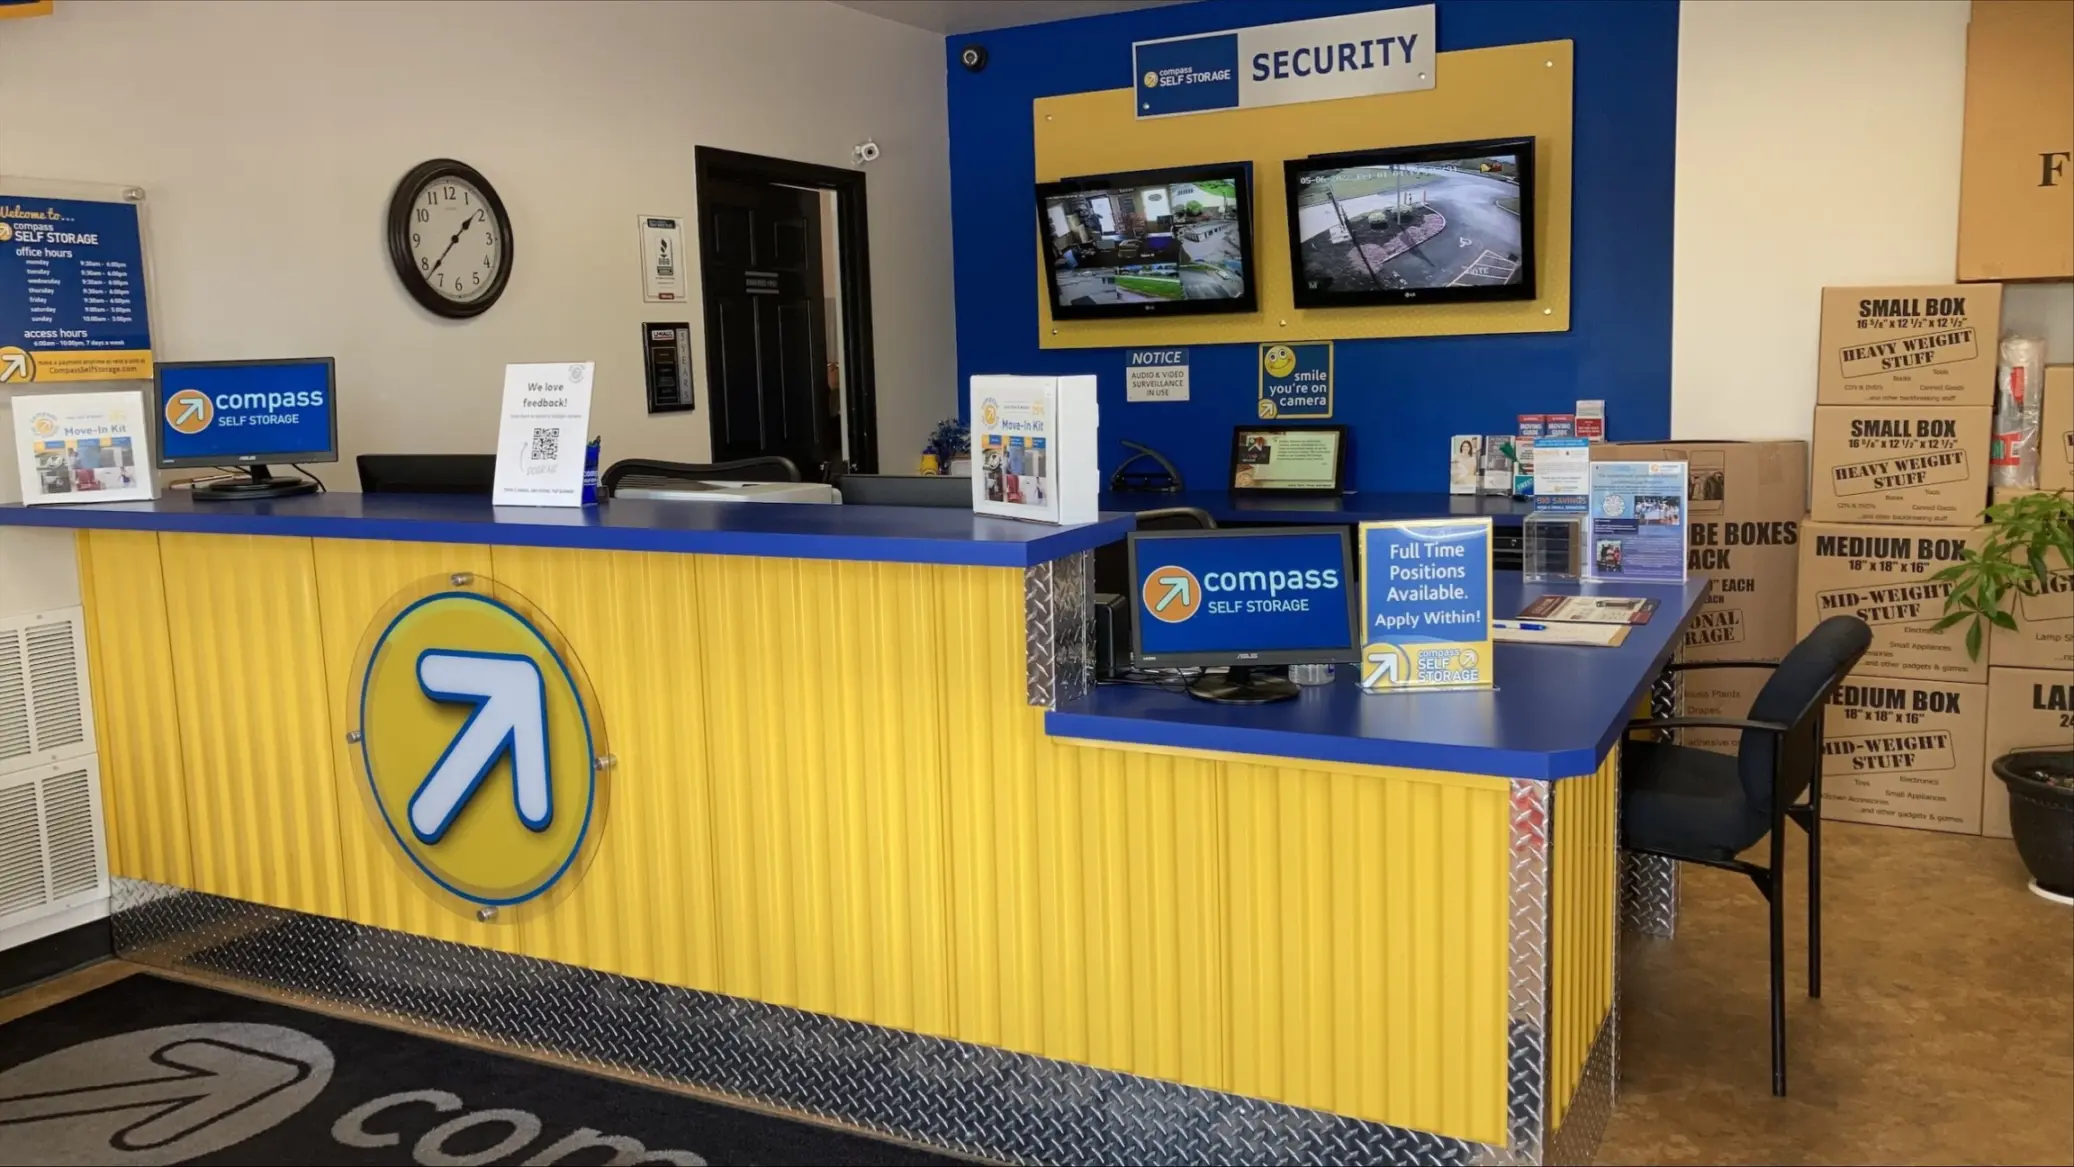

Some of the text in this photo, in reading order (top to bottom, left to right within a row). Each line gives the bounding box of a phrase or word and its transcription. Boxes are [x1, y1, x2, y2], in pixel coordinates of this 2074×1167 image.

[1252, 34, 1418, 82] SECURITY
[1159, 66, 1193, 78] compass
[1160, 70, 1230, 87] SELF STORAGE
[428, 192, 438, 204] 11
[444, 186, 456, 200] 12
[464, 192, 468, 205] 1
[0, 204, 46, 219] Welcome
[416, 208, 429, 222] 10
[478, 208, 485, 222] 2
[14, 222, 54, 234] compass
[15, 231, 98, 245] SELF STORAGE
[412, 233, 420, 248] 9
[486, 232, 493, 245] 3
[16, 246, 72, 258] office hours
[422, 257, 429, 270] 8
[484, 254, 490, 268] 4
[438, 273, 444, 287] 7
[455, 277, 462, 291] 6
[472, 272, 480, 284] 5
[1860, 297, 1966, 318] SMALL BOX
[1857, 319, 1868, 328] 16
[1889, 320, 1895, 328] x
[1898, 318, 1908, 328] 12
[1928, 320, 1934, 328] x
[1938, 318, 1948, 328] 12
[24, 328, 88, 338] access hours
[1842, 330, 1972, 362] HEAVY WEIGHT
[1132, 351, 1182, 365] NOTICE
[1882, 351, 1935, 370] STUFF
[1163, 370, 1184, 378] VIDEO
[1294, 370, 1327, 382] smile
[528, 382, 564, 392] We love
[1132, 380, 1184, 388] SURVEILLANCE
[1270, 383, 1327, 396] you're on
[1156, 388, 1169, 396] USE
[216, 390, 324, 414] compass
[522, 398, 568, 408] feedback!
[1280, 397, 1327, 406] camera
[218, 414, 300, 426] SELF STORAGE
[1002, 419, 1044, 432] Move-In Kit
[64, 424, 126, 436] Move-In Kit
[1851, 420, 1956, 438] SMALL BOX
[1849, 440, 1860, 448] 16
[1889, 440, 1899, 448] 12
[1928, 439, 1938, 448] 12
[1836, 452, 1963, 480] HEAVY WEIGHT
[1874, 472, 1926, 489] STUFF
[1687, 521, 1798, 546] BE BOXES
[1390, 542, 1464, 560] Full Time
[1816, 536, 1966, 560] MEDIUM BOX
[1390, 564, 1466, 580] Positions
[1848, 560, 1930, 573] 18" x 18" x 16"
[1204, 569, 1339, 597] compass
[1722, 578, 1754, 592] EACH
[1386, 584, 1468, 602] Available.
[1821, 583, 1952, 610] MID-WEIGHT
[1208, 599, 1310, 614] SELF STORAGE
[1856, 604, 1920, 622] STUFF
[1374, 610, 1480, 630] Apply Within!
[2036, 632, 2062, 642] Lamp
[1890, 641, 1952, 652] Small Appliances
[1418, 649, 1460, 659] compass
[1418, 658, 1450, 670] SELF
[1880, 660, 1899, 668] other
[1902, 662, 1932, 671] gadgets
[1418, 670, 1478, 682] STORAGE
[1912, 690, 1960, 714] BOX
[1844, 708, 1924, 724] 18" x 18" x 16"
[1852, 754, 1916, 770] STUFF
[1900, 776, 1940, 786] Electronics
[1885, 790, 1947, 802] Small Appliances
[1876, 808, 1895, 816] other
[1898, 809, 1926, 819] gadgets
[1929, 812, 1935, 820] &
